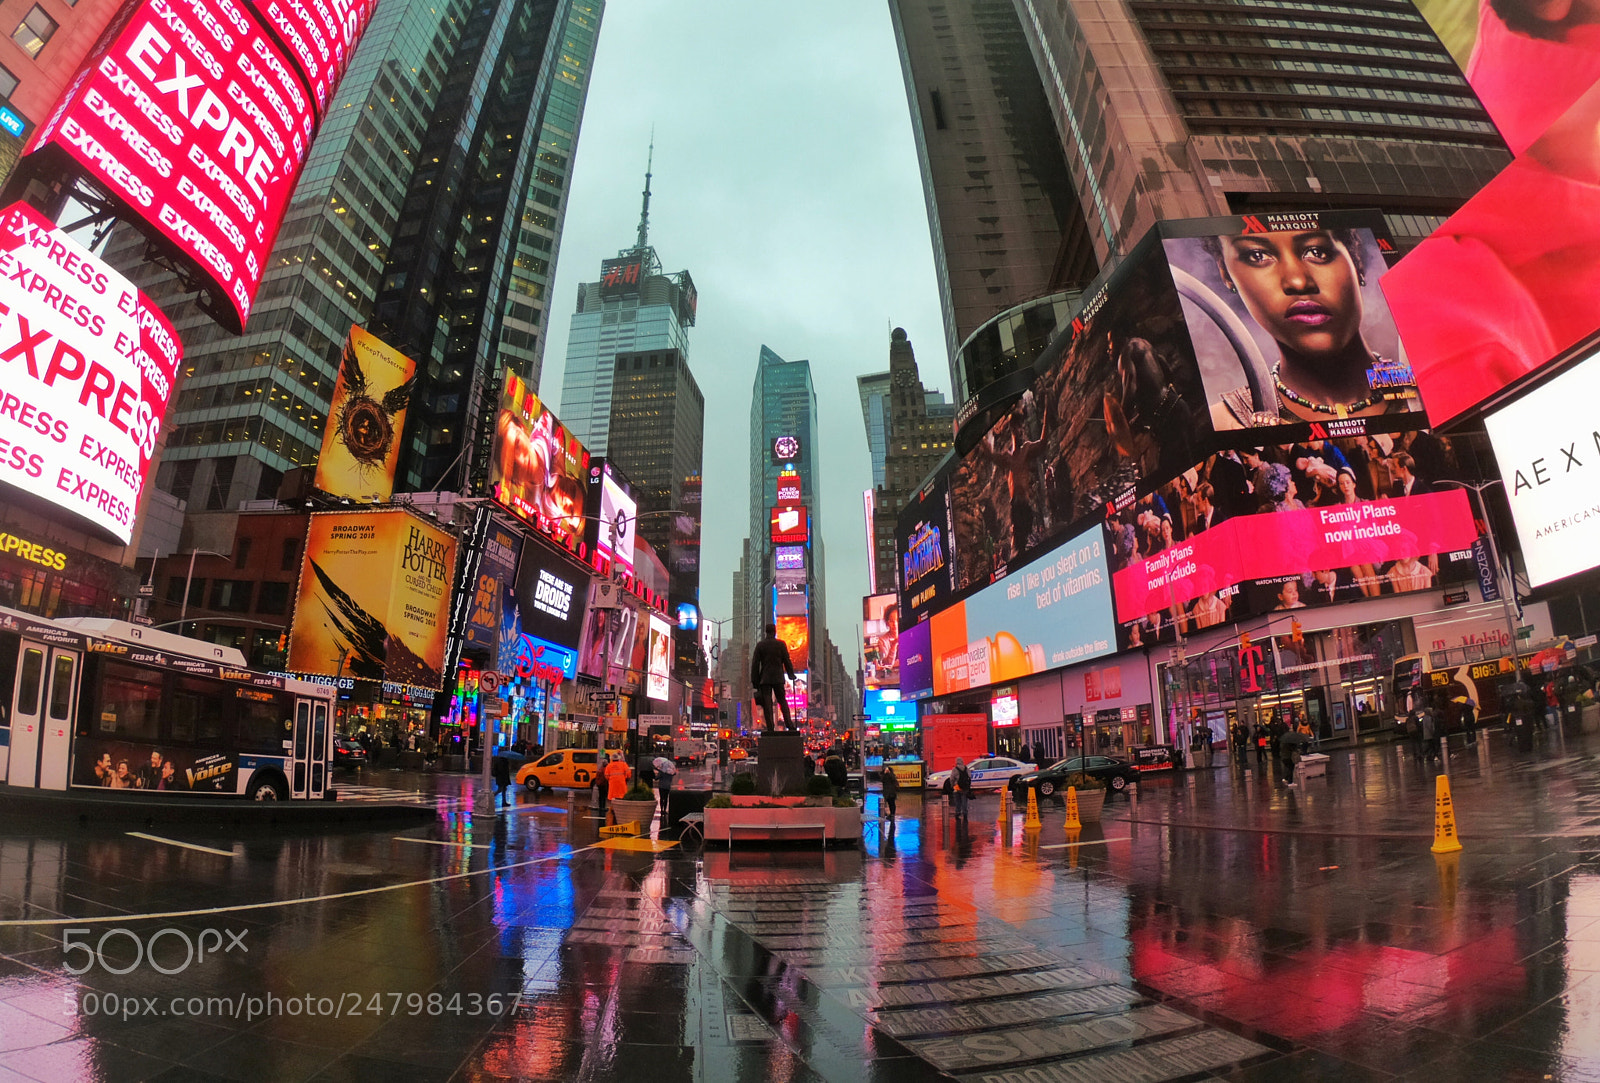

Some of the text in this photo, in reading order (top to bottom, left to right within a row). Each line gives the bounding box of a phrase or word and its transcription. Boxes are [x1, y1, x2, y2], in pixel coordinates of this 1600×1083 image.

[183, 0, 234, 52] RESS
[215, 0, 250, 35] ESS
[150, 0, 225, 80] EXPRESS
[268, 2, 318, 78] EXPRESS
[252, 37, 305, 114] EXPRESS
[237, 53, 293, 131] EXPRESS
[126, 21, 279, 211] EXPRE
[227, 80, 284, 158] EXPRESS
[99, 55, 256, 223] EXPRESS EXPRESS
[83, 88, 246, 253] EXPRESS EXPRESS
[59, 117, 233, 282] EXPRESS EXPRESS
[1267, 213, 1320, 223] MARRIOTT
[1270, 221, 1319, 231] MARQUIS
[1083, 283, 1109, 315] MARRIOTT
[1084, 294, 1108, 324] MARQUIS
[117, 291, 178, 366] EXPRESS
[114, 331, 170, 402] EXPRESS
[357, 340, 409, 375] #KeepTheSecrets
[1328, 419, 1366, 428] MARRIOTT
[1329, 426, 1365, 436] MARQUIS
[79, 434, 143, 494] EXPRESS
[1514, 457, 1551, 496] AE
[1560, 442, 1583, 473] X
[56, 467, 130, 530] EXPRESS
[1320, 504, 1397, 525] Family Plans
[408, 525, 450, 563] HARRY
[771, 534, 808, 542] TOSHIBA
[1325, 521, 1401, 543] now include
[401, 544, 448, 585] POTTER
[1007, 581, 1021, 600] rise
[1027, 570, 1040, 592] like
[1041, 567, 1056, 586] you
[1057, 556, 1078, 577] slept
[1079, 548, 1092, 564] on
[1093, 541, 1100, 558] a
[1145, 545, 1193, 574] Family Plans
[1475, 545, 1496, 595] FROZEN
[405, 575, 426, 590] CURSED
[592, 550, 669, 615] BRADWAY
[1036, 568, 1104, 609] bed of vitamins.
[1148, 575, 1165, 591] now
[1219, 584, 1240, 600] NETFLIX
[1255, 578, 1272, 586] WATCH
[1282, 575, 1301, 583] CROWN
[534, 580, 571, 613] DROIDS
[404, 611, 424, 624] SPRING
[405, 604, 436, 619] BROADWAY
[26, 626, 68, 637] AMERICA'S
[43, 635, 79, 644] FAVORITE
[86, 637, 128, 655] Voice
[131, 653, 144, 662] FEB
[145, 654, 154, 662] 26
[173, 660, 205, 668] AMERICA'S
[1052, 640, 1109, 664] drink outside the lines
[186, 666, 214, 674] FAVORITE
[219, 667, 251, 681] Voice
[254, 678, 264, 686] FEB
[970, 661, 987, 677] zero
[1472, 664, 1507, 679] BIGBU
[383, 682, 435, 700] GIFTS LUGGAGE
[186, 762, 232, 789] Voice
[1140, 762, 1173, 771] CHICAGO
[962, 1006, 1201, 1063] SIMON
